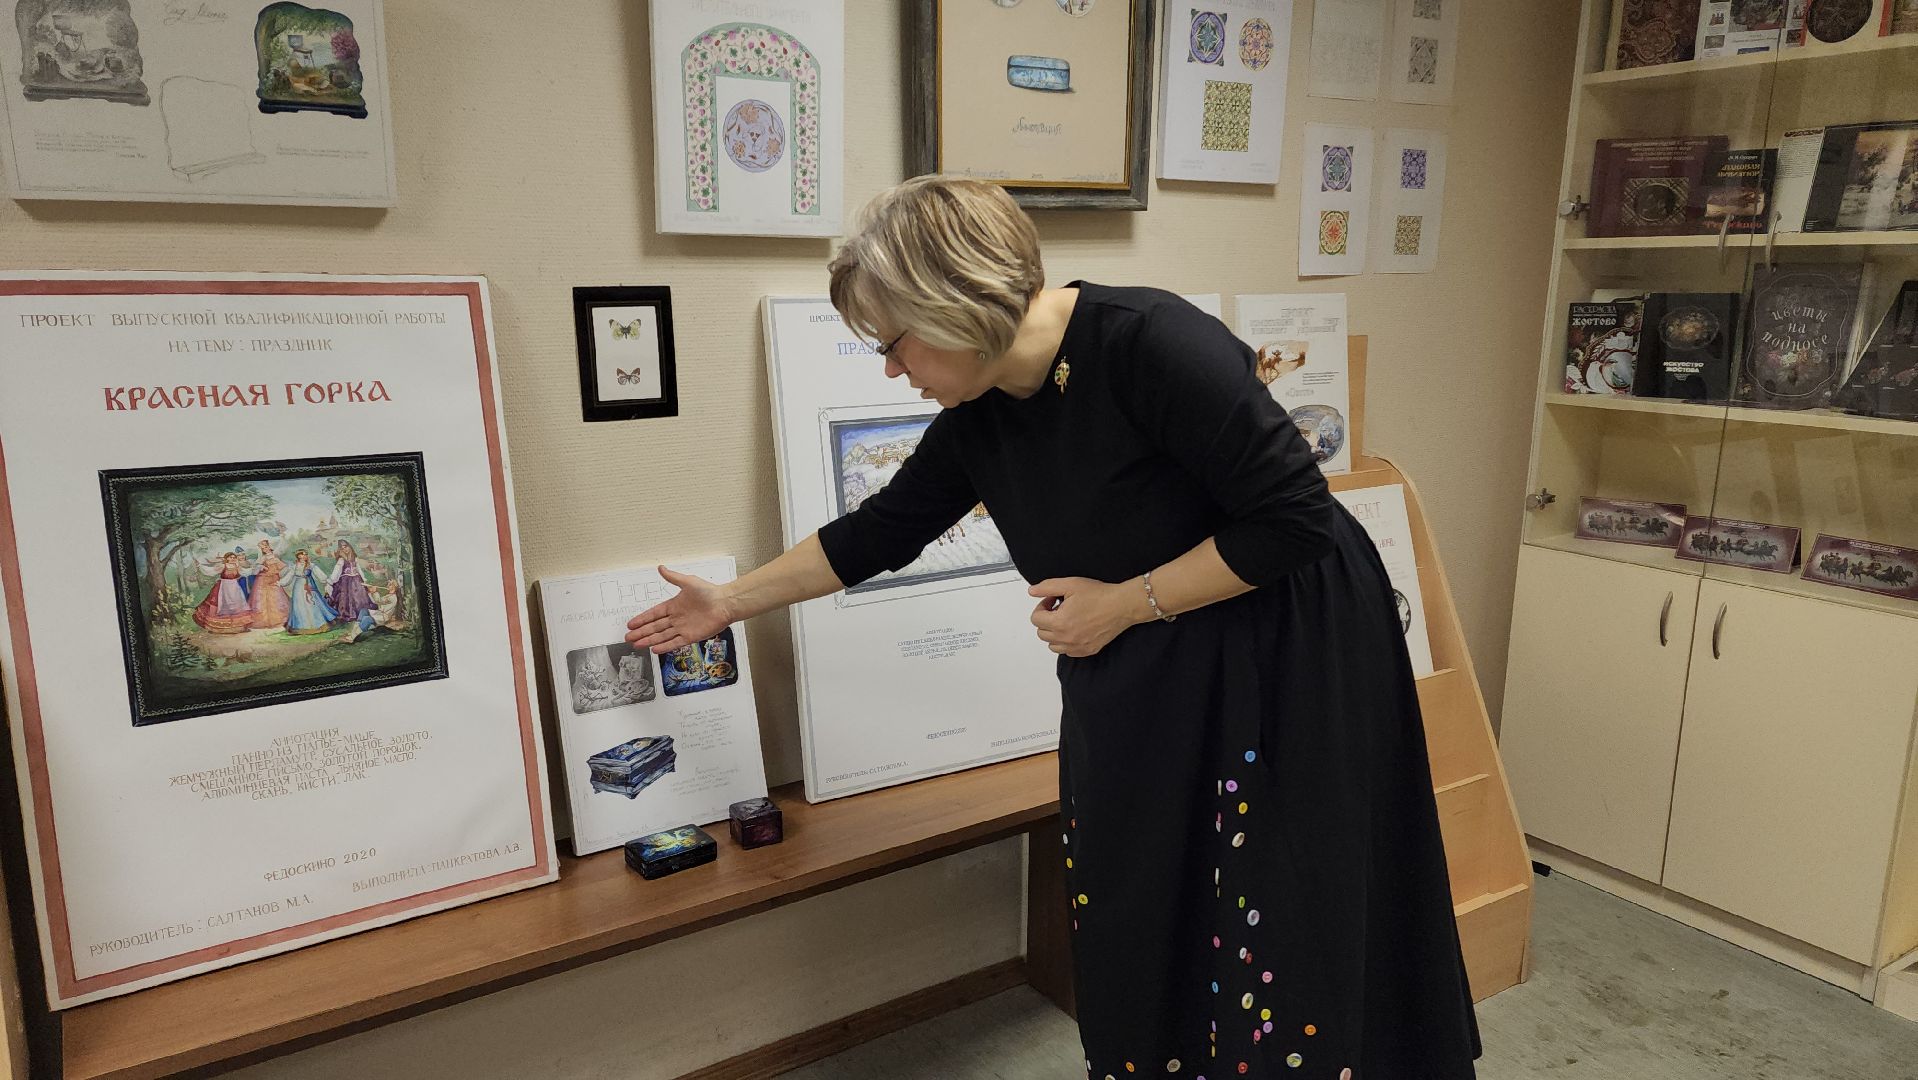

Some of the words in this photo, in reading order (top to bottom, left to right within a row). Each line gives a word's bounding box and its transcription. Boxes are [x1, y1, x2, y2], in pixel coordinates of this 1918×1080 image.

[19, 313, 95, 328] ПРОЕКТ
[112, 309, 217, 326] ВЫПУСКНОЙ
[224, 309, 388, 326] КВАЛИФИКАЦИОННОЙ
[394, 312, 446, 325] РАБОТЫ
[1572, 317, 1617, 326] ЖОСТОВО
[168, 340, 190, 353] НА
[251, 338, 332, 352] ПРАЗДНИК
[837, 341, 880, 356] ПРАЗ
[102, 383, 271, 411] КРАСНАЯ
[284, 380, 392, 405] ГОРКА
[231, 749, 274, 766] ПАННО
[276, 747, 293, 758] ИЗ
[298, 730, 376, 753] ПАПЬЕ-МАШЕ
[270, 728, 339, 748] АННОТАЦИЯ
[168, 764, 247, 788] ЖЕМЧУЖНЫЙ
[322, 738, 384, 758] СУСАЛЬНОЕ
[190, 772, 263, 794] СМЕШАННОЕ
[319, 750, 367, 768] ЗОЛОТОЙ
[200, 775, 291, 802] АЛЮМИНИЕВАЯ
[263, 856, 336, 882] ФЕДОСКИНО
[343, 847, 376, 865] 2020
[207, 901, 280, 928] САЛТАНОВ
[432, 847, 500, 875] ПАНКРАТОВА
